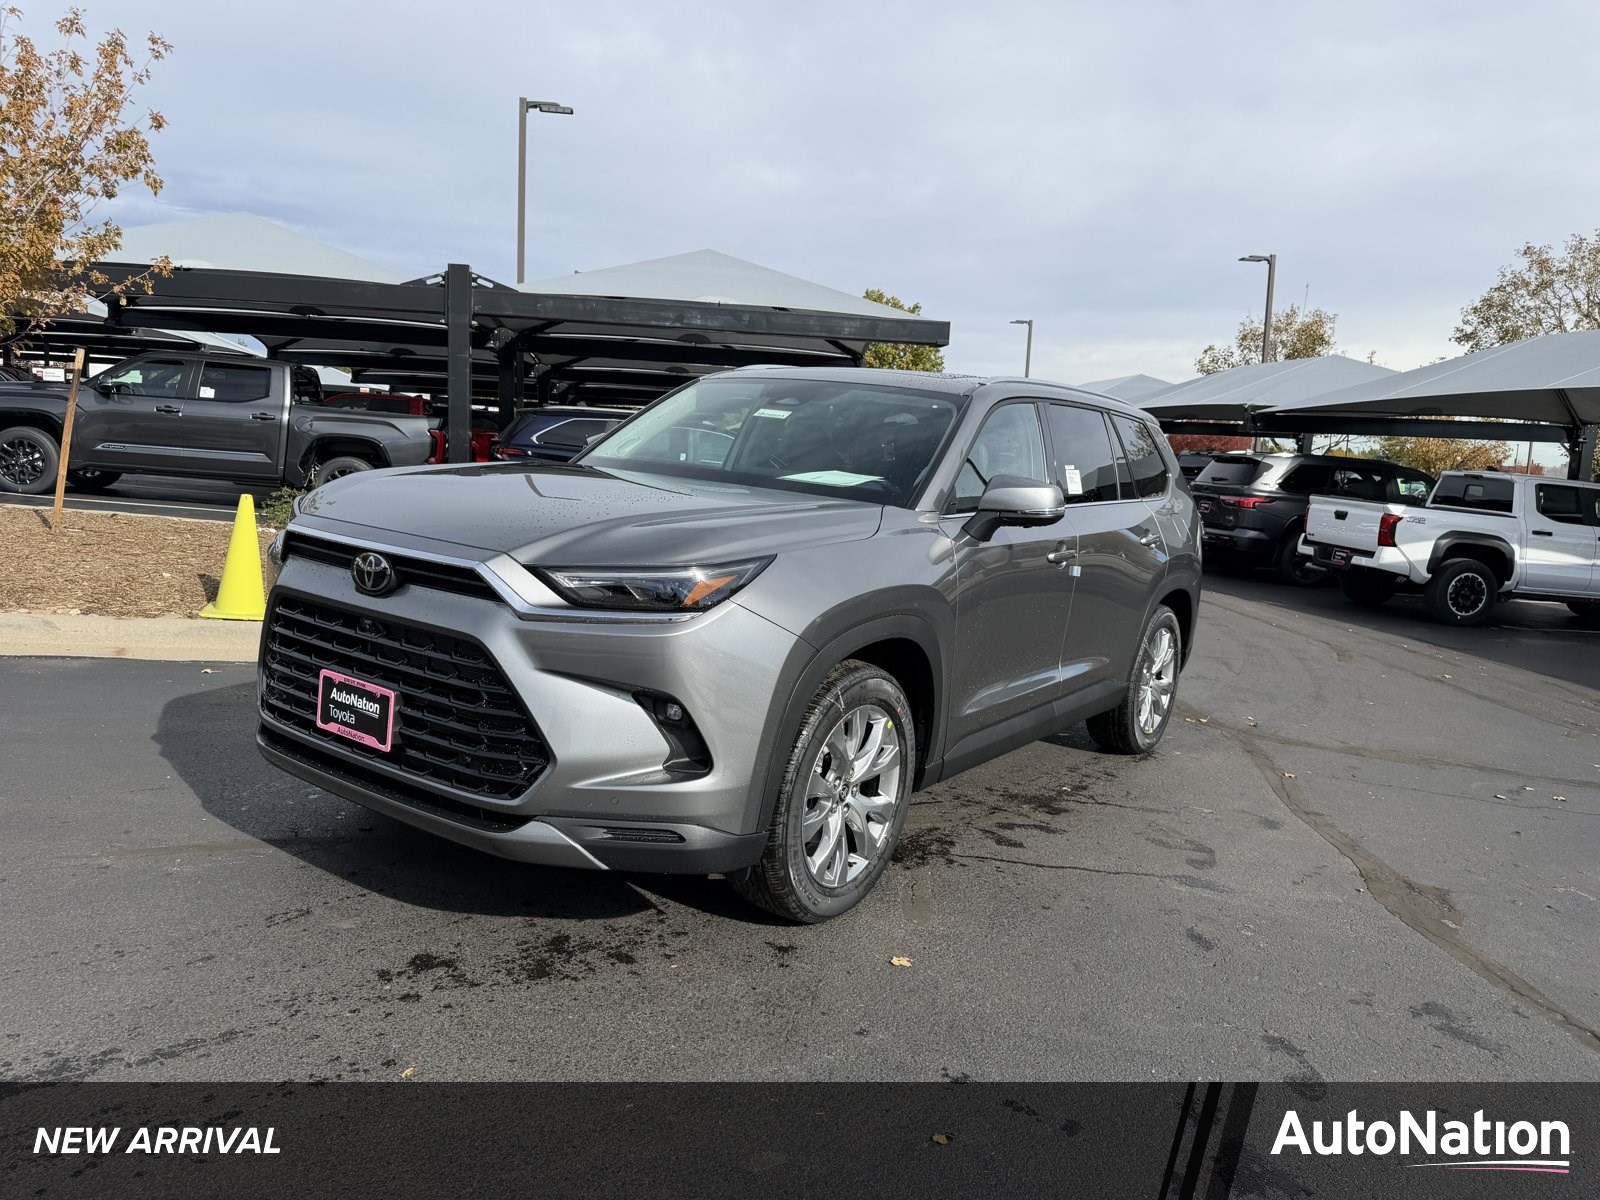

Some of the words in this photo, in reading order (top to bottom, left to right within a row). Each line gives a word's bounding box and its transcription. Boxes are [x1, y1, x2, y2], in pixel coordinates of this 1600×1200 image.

[330, 687, 380, 714] AutoNation
[328, 704, 355, 724] Toyota
[337, 726, 365, 742] AutoNation
